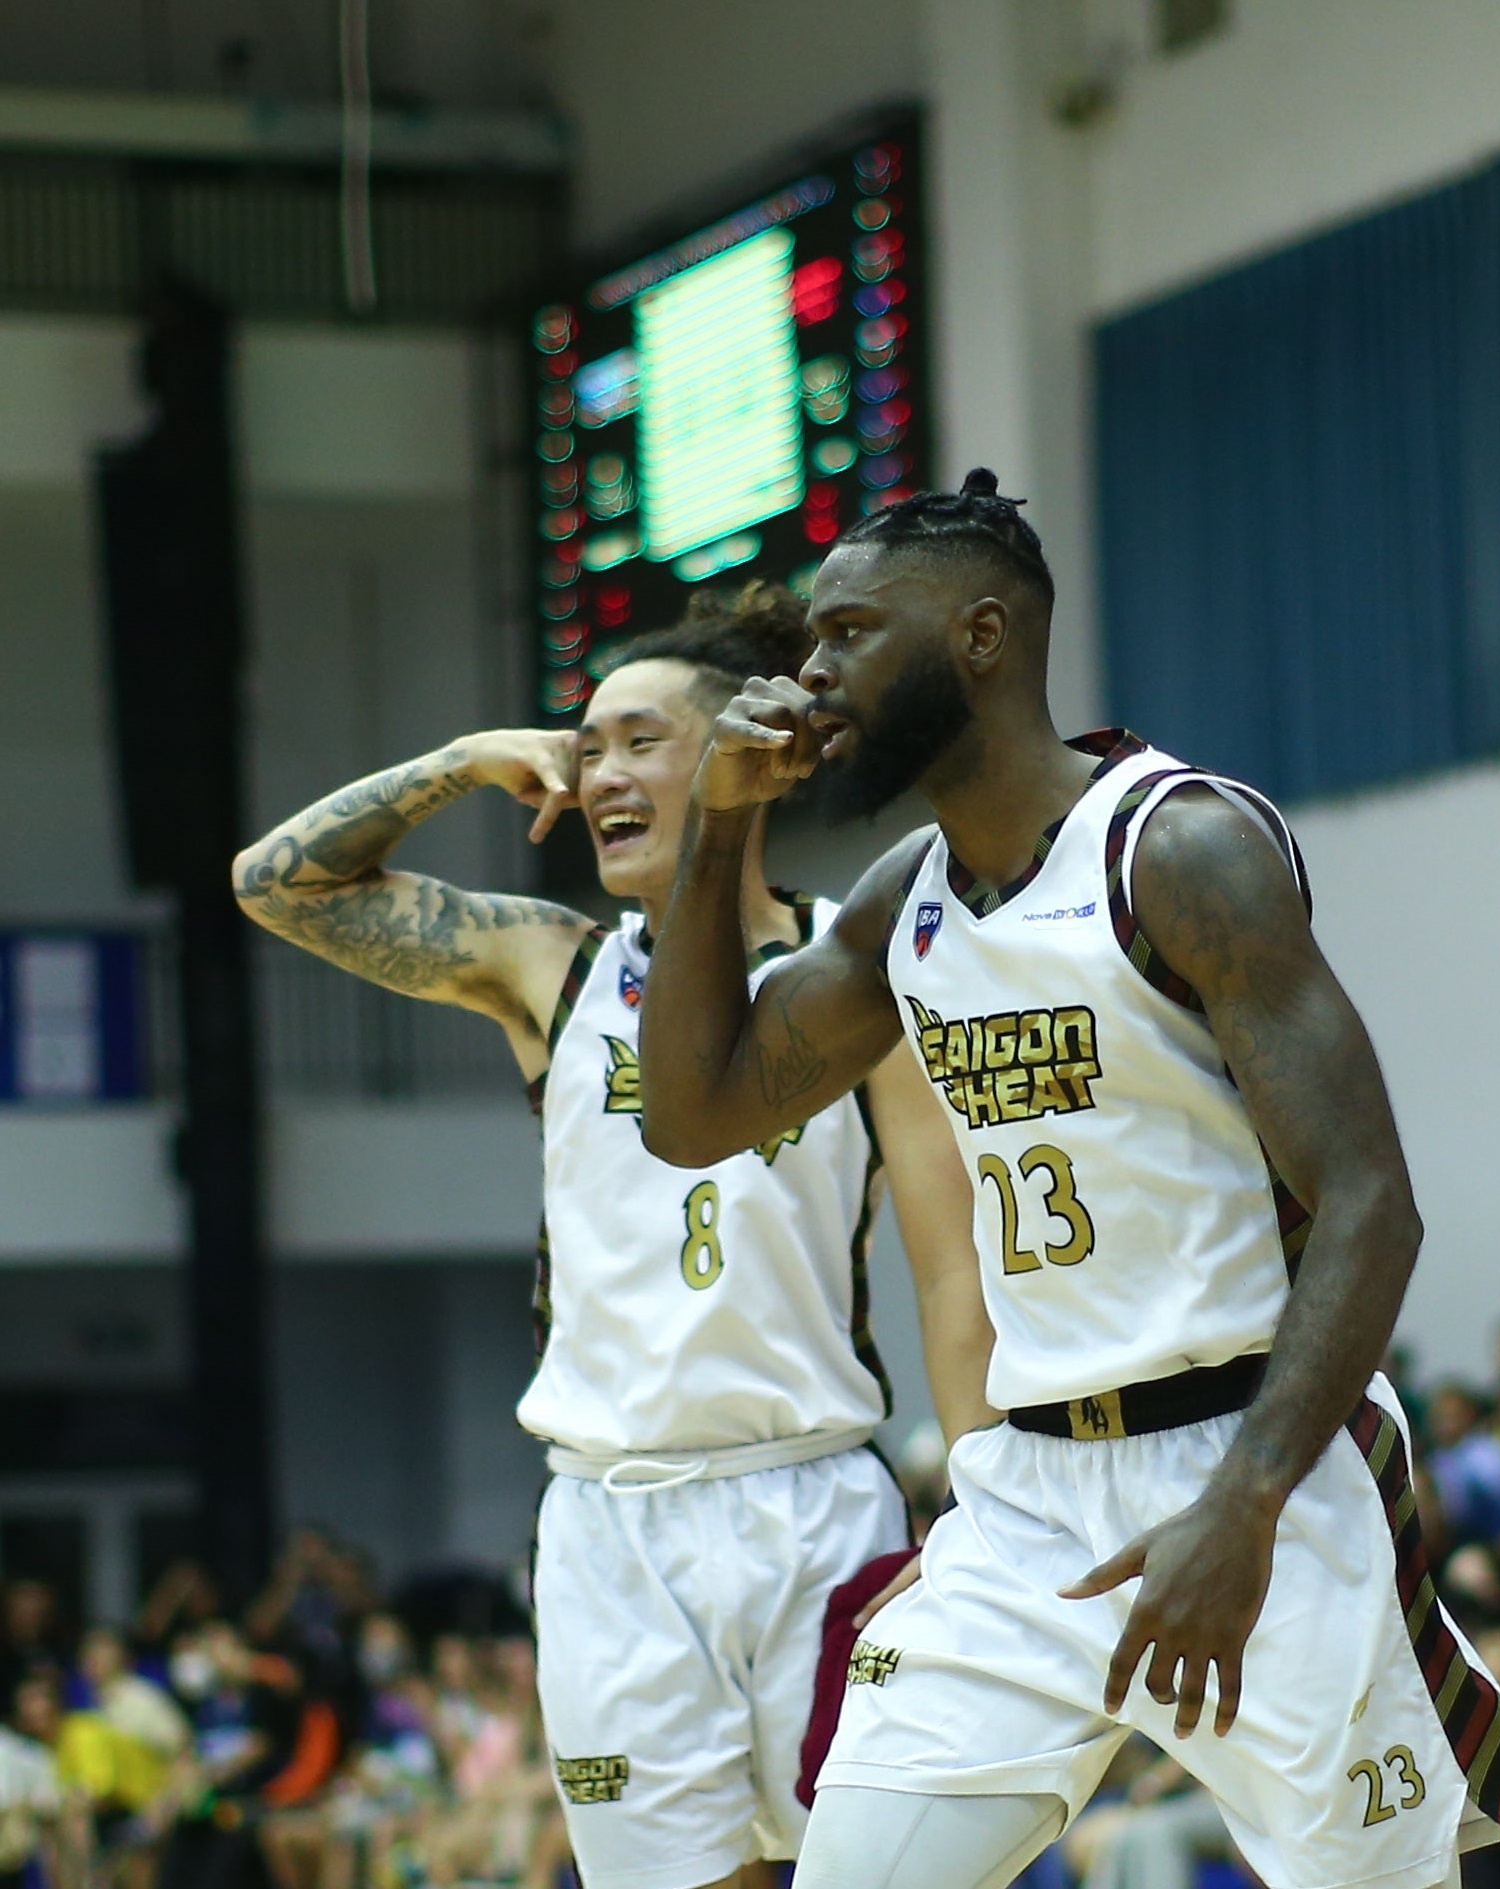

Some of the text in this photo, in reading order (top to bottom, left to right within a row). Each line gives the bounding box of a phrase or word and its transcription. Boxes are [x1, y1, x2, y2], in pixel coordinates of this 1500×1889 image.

[914, 1004, 1098, 1082] SAIGON
[959, 1058, 1103, 1130] HEAT
[681, 1180, 724, 1291] 8
[977, 1143, 1096, 1275] 23
[1347, 1744, 1425, 1828] 23
